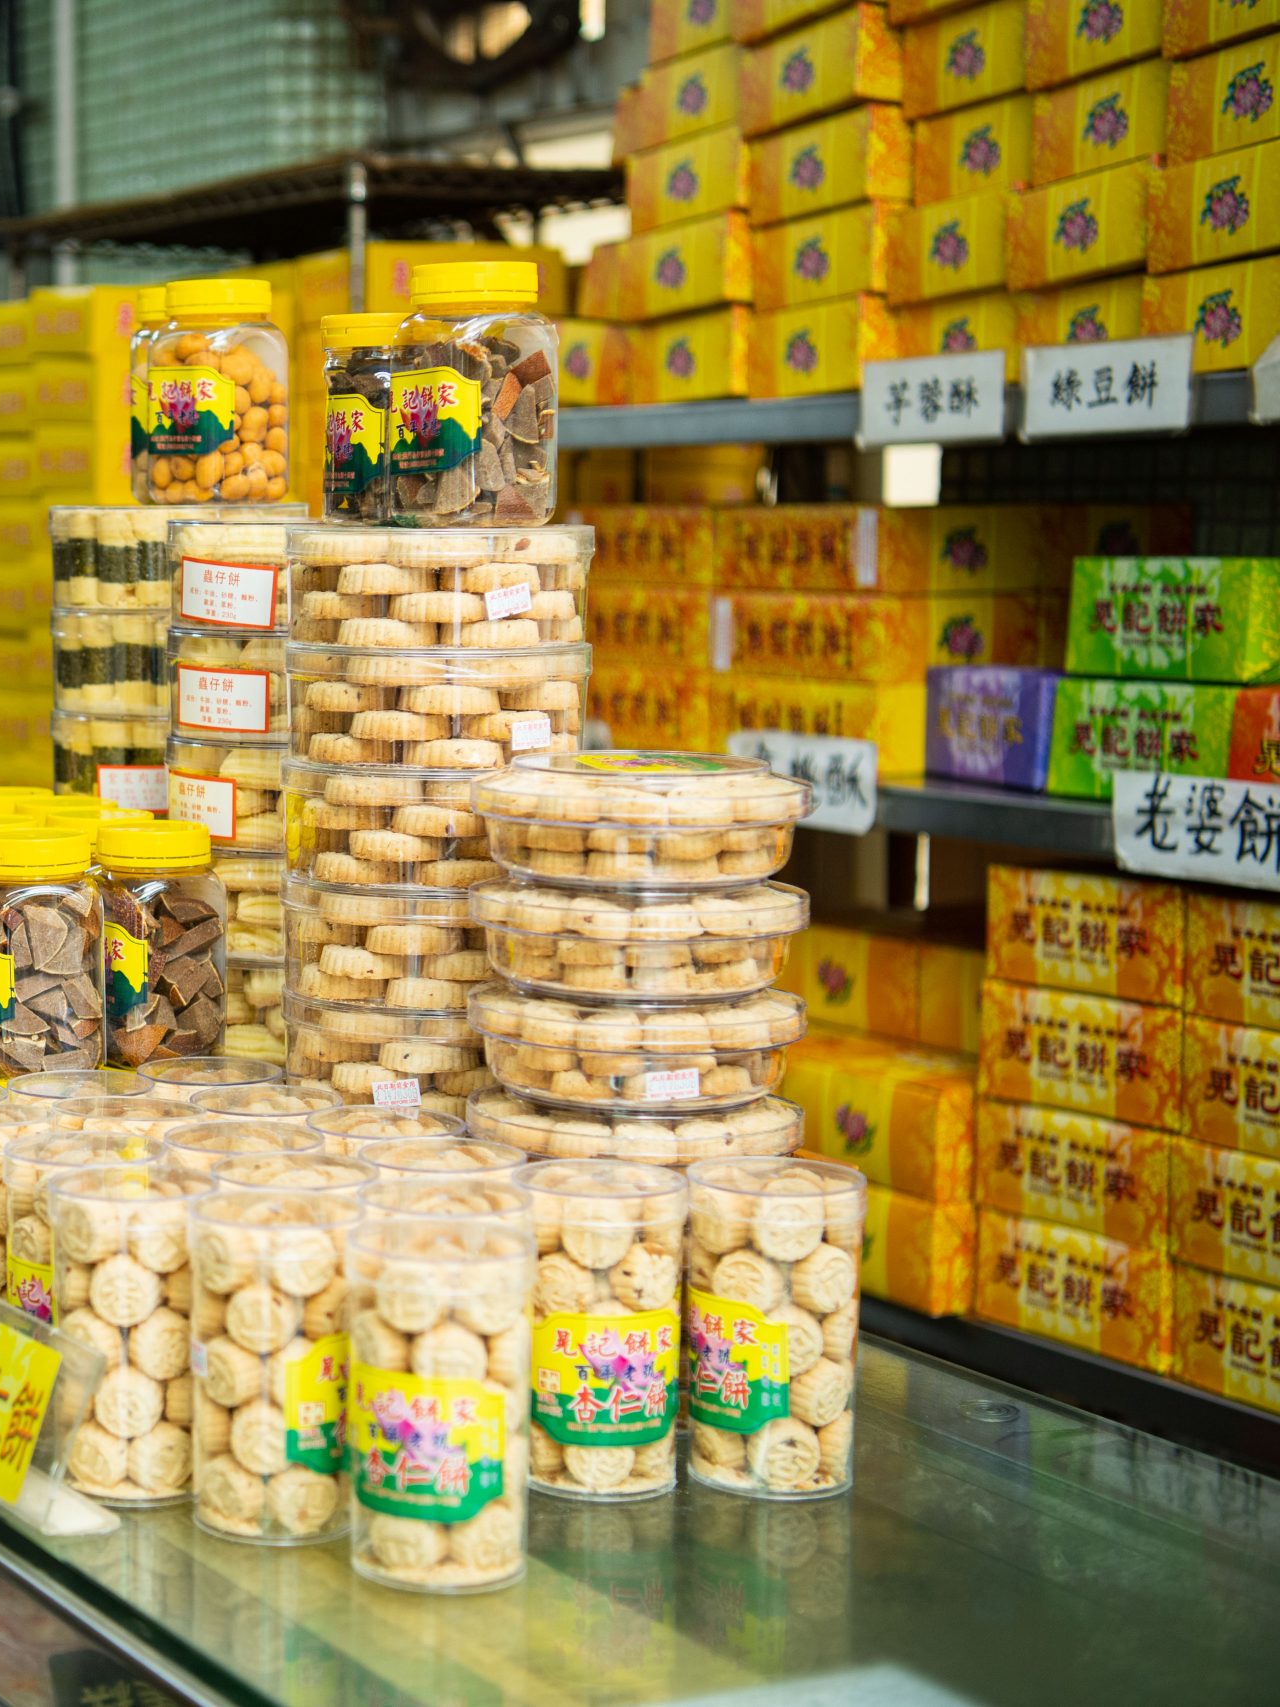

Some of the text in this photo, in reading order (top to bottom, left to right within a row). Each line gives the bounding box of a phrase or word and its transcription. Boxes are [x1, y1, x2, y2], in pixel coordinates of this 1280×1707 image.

[885, 375, 979, 427] 芋蓉酥
[1050, 359, 1160, 411] 綠豆餅
[1134, 772, 1280, 893] 老婆餅
[553, 1327, 672, 1357] 晃記餅家
[569, 1380, 668, 1424] 杏仁餅
[367, 1448, 470, 1495] 杏仁餅
